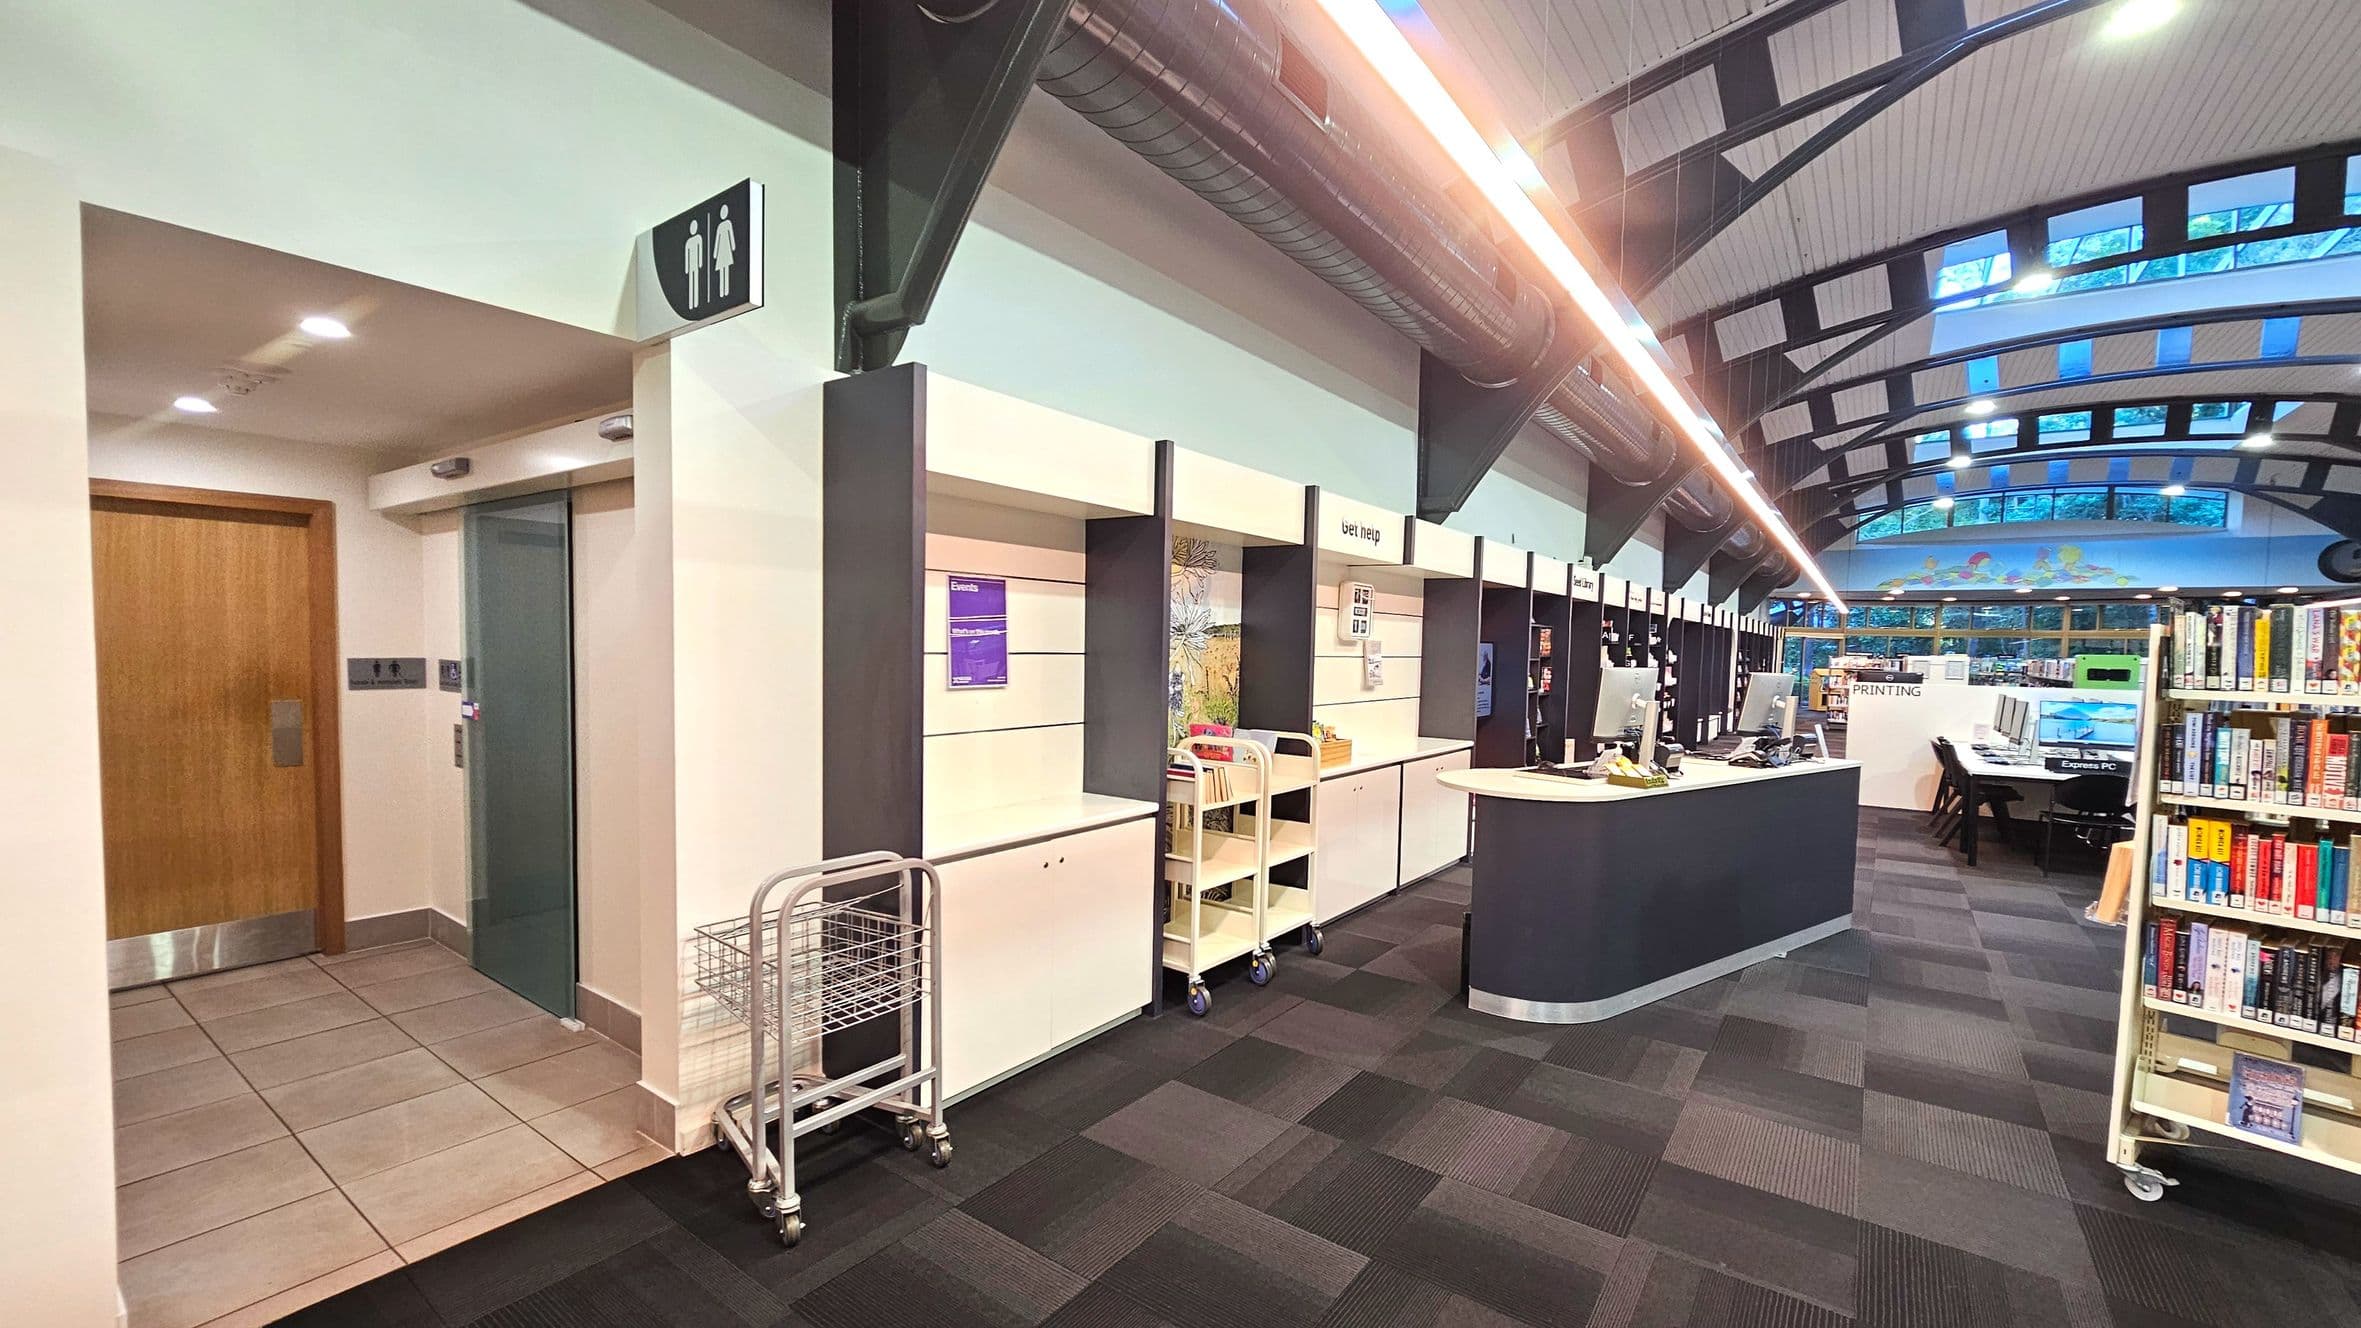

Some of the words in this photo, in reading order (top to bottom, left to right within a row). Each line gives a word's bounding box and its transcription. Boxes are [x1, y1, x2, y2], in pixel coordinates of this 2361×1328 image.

[1342, 516, 1358, 537] Get
[1360, 521, 1381, 547] help
[951, 582, 979, 593] Events
[1853, 684, 1921, 697] PRINTING
[2061, 760, 2099, 770] Express
[2101, 762, 2117, 771] PC
[2322, 756, 2347, 790] MOTIVE
